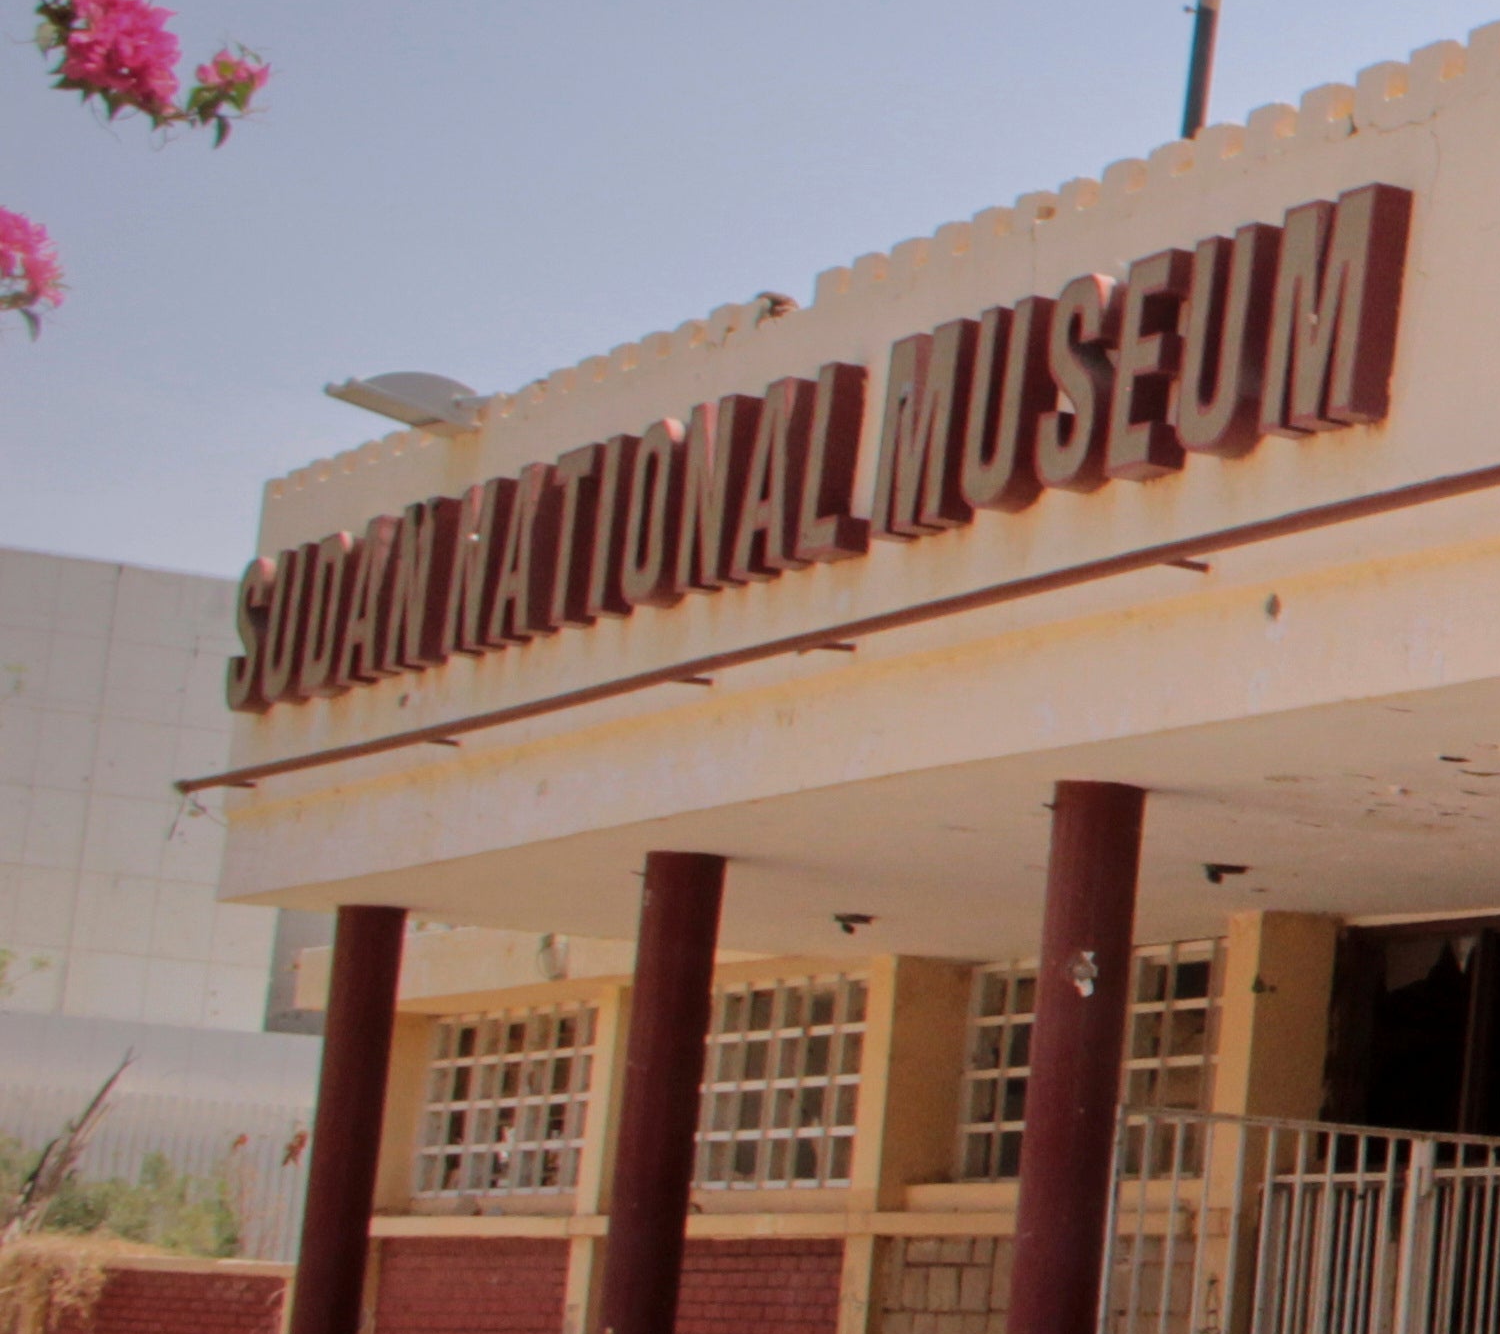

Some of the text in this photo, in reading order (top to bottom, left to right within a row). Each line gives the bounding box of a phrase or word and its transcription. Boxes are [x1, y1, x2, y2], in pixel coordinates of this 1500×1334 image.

[227, 182, 1413, 714] SUDAN NATIONAL MUSEUM
